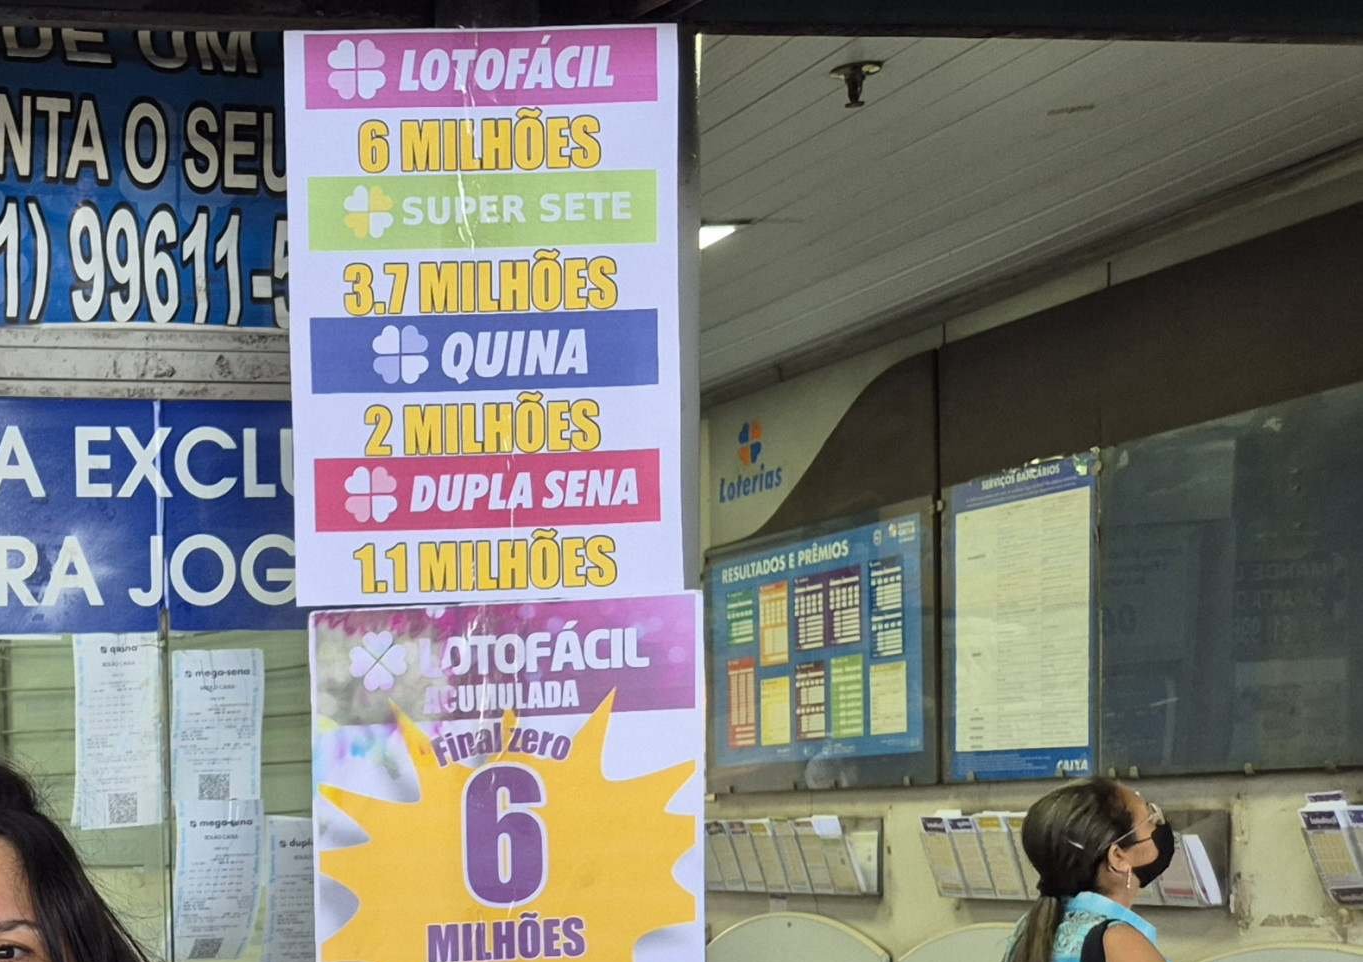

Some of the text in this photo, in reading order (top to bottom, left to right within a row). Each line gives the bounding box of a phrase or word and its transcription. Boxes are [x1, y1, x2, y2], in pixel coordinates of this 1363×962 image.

[399, 35, 615, 91] LOTOFÁCIL
[125, 101, 167, 185] O
[184, 106, 288, 193] SEU
[357, 107, 602, 173] 6 MILHÕES
[402, 191, 632, 226] SUPER SETE
[343, 248, 618, 316] 3.7 MILHÕES
[441, 329, 588, 385] QUINA
[364, 391, 602, 456] 2 MILHÕES
[75, 426, 293, 500] EXCL
[410, 468, 639, 512] DUPLA SENA
[719, 465, 783, 504] Loterias
[129, 534, 295, 606] JOG
[353, 528, 618, 593] 1.1 MILHÕES
[721, 540, 850, 584] RESULTADOS E PRÊMIOS
[418, 620, 650, 680] LOTOFÁCIL
[423, 680, 579, 715] ACUMULADA
[431, 722, 572, 768] Final zero
[463, 762, 546, 906] 6
[427, 911, 586, 962] MILHÕES
